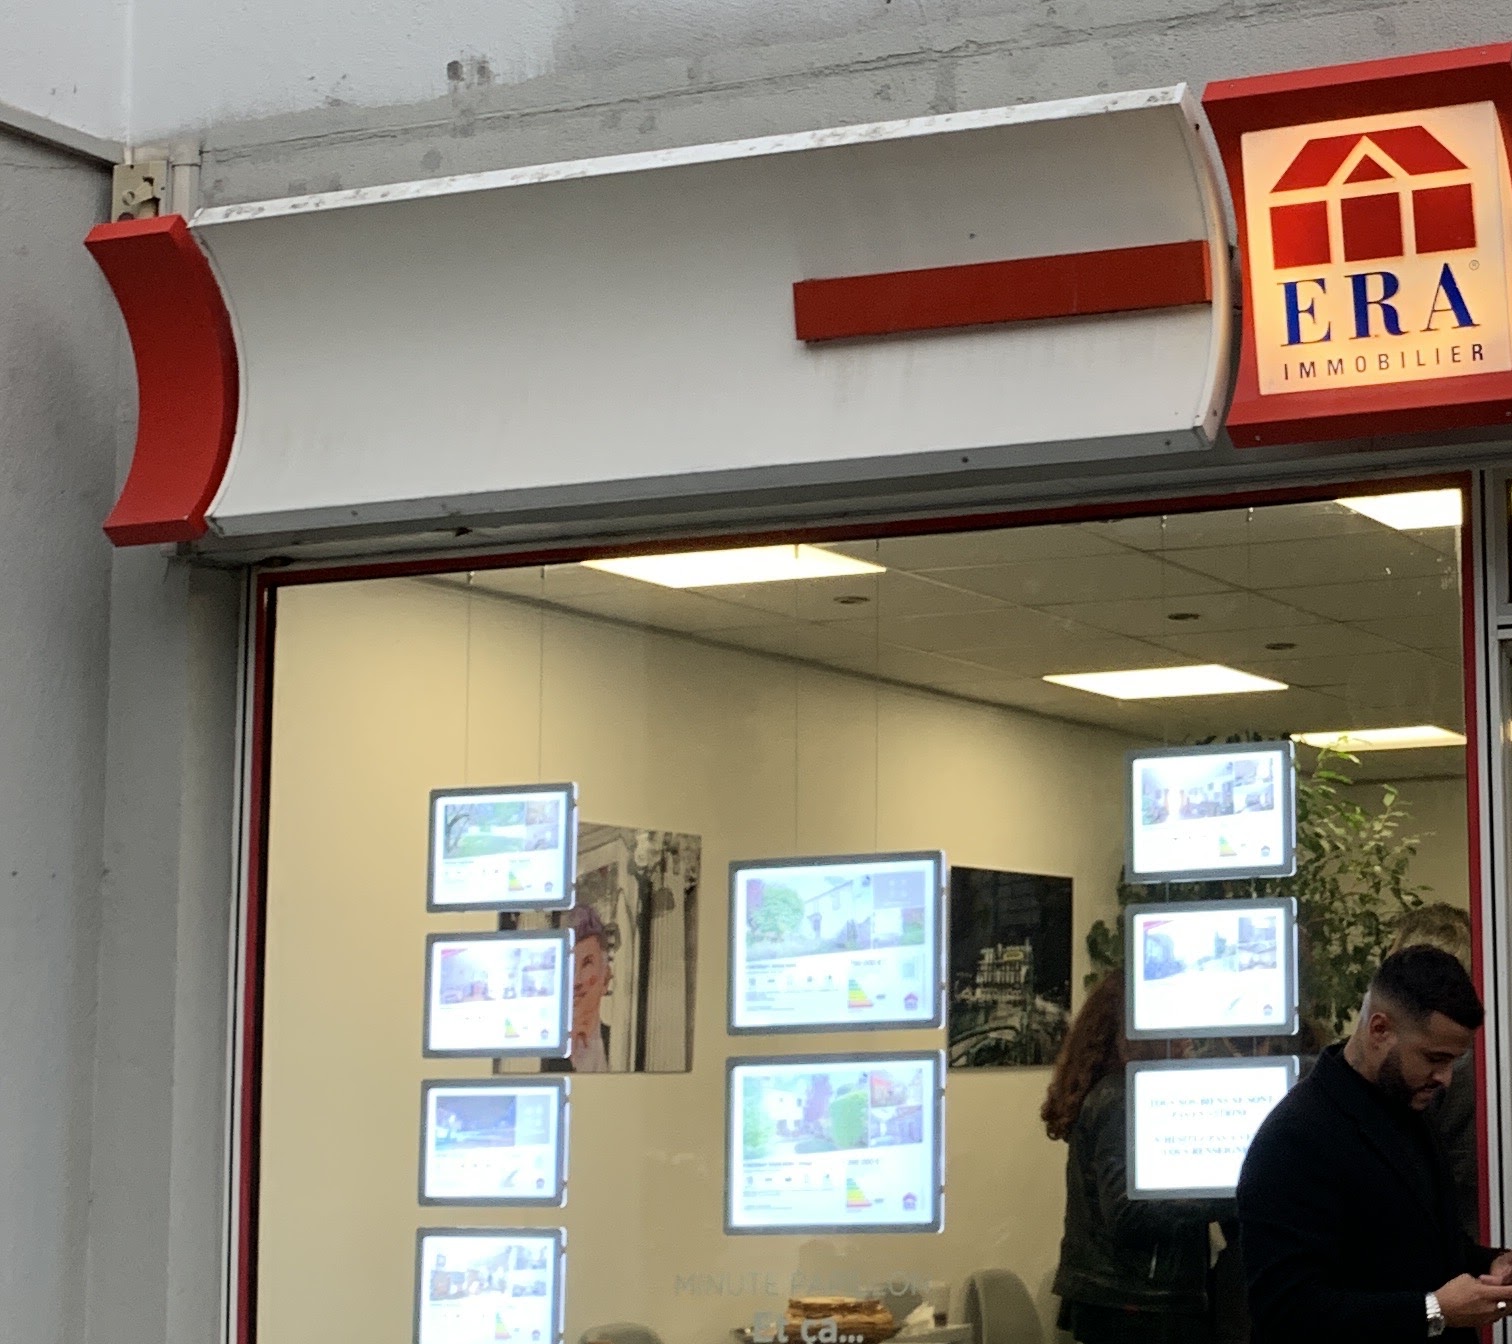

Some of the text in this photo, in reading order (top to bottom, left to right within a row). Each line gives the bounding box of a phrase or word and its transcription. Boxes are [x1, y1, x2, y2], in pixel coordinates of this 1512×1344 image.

[1277, 262, 1480, 347] ERA
[1283, 343, 1485, 381] IMMOBILIER
[674, 1270, 779, 1297] MINUTE
[753, 1311, 789, 1344] Et
